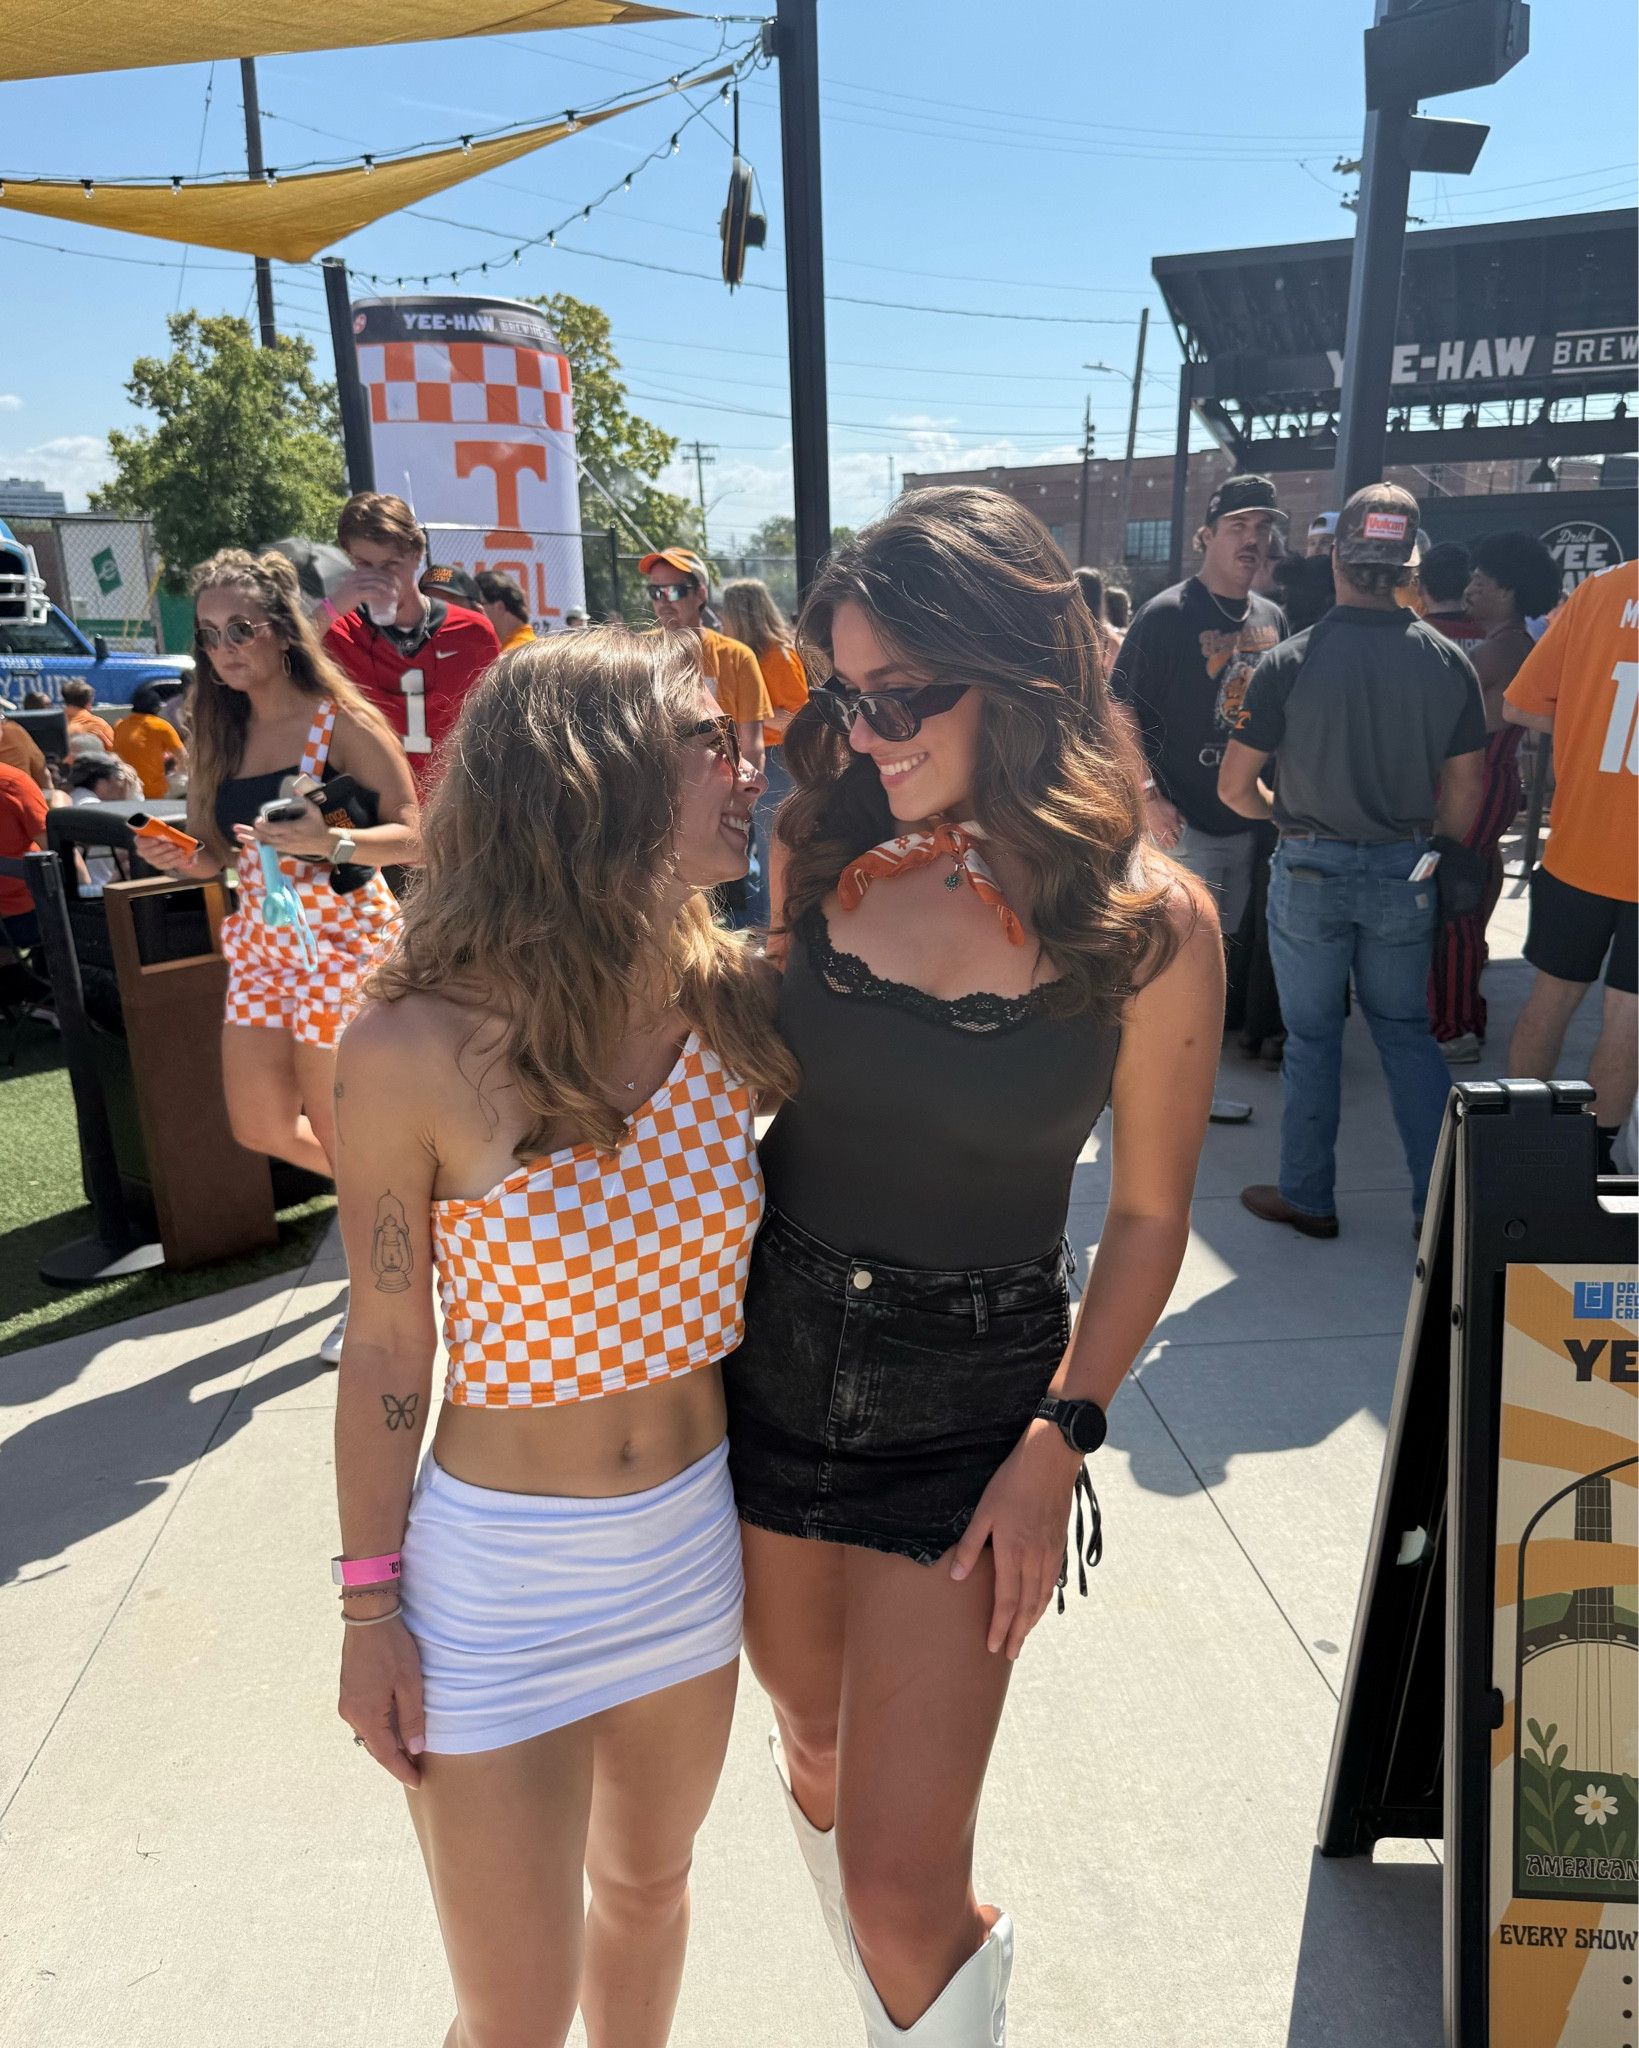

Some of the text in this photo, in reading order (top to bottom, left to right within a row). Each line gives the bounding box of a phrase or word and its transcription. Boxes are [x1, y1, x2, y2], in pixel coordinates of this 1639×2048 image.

[403, 313, 495, 331] YEE-HAW
[1326, 335, 1638, 388] YE-HAW BREW
[454, 441, 547, 550] T
[1556, 527, 1597, 543] Drink
[400, 668, 432, 754] 1
[1617, 1282, 1638, 1293] OR
[1564, 1339, 1638, 1382] YE
[1526, 1855, 1638, 1881] AMERICAN
[1499, 1924, 1638, 1950] EVERY SHOW
